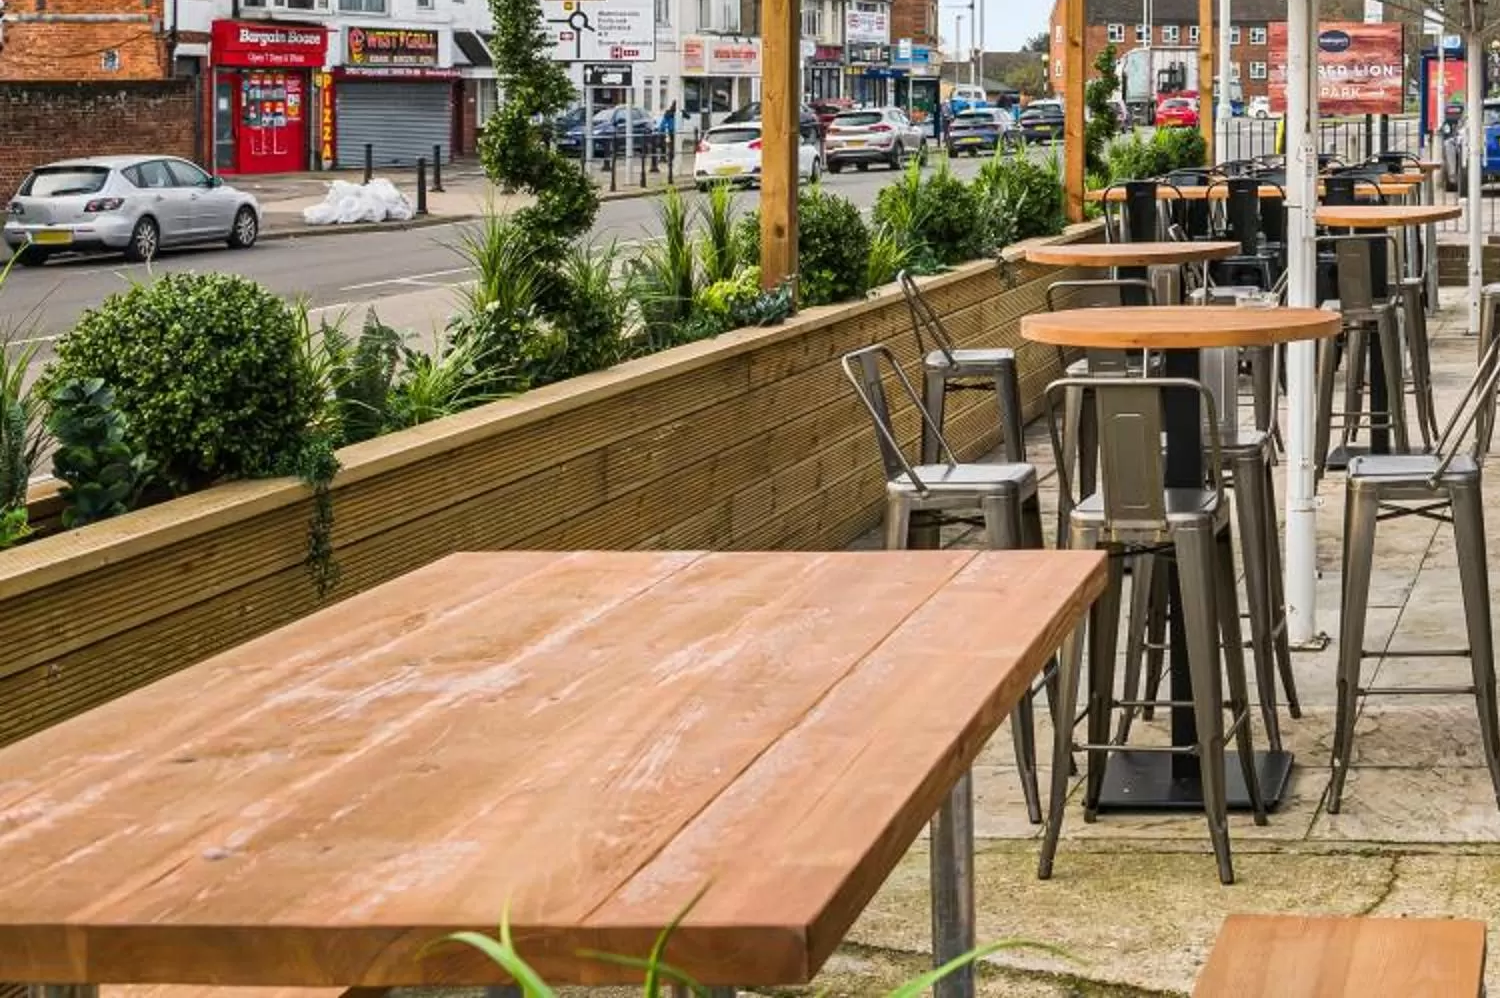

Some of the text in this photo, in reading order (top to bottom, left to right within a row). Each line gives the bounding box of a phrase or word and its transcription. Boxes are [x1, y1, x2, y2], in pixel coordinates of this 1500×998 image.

[239, 28, 321, 47] Bargain Booze
[1317, 65, 1393, 77] RED LION
[1321, 87, 1361, 99] PARK
[322, 73, 333, 159] PIZZA
